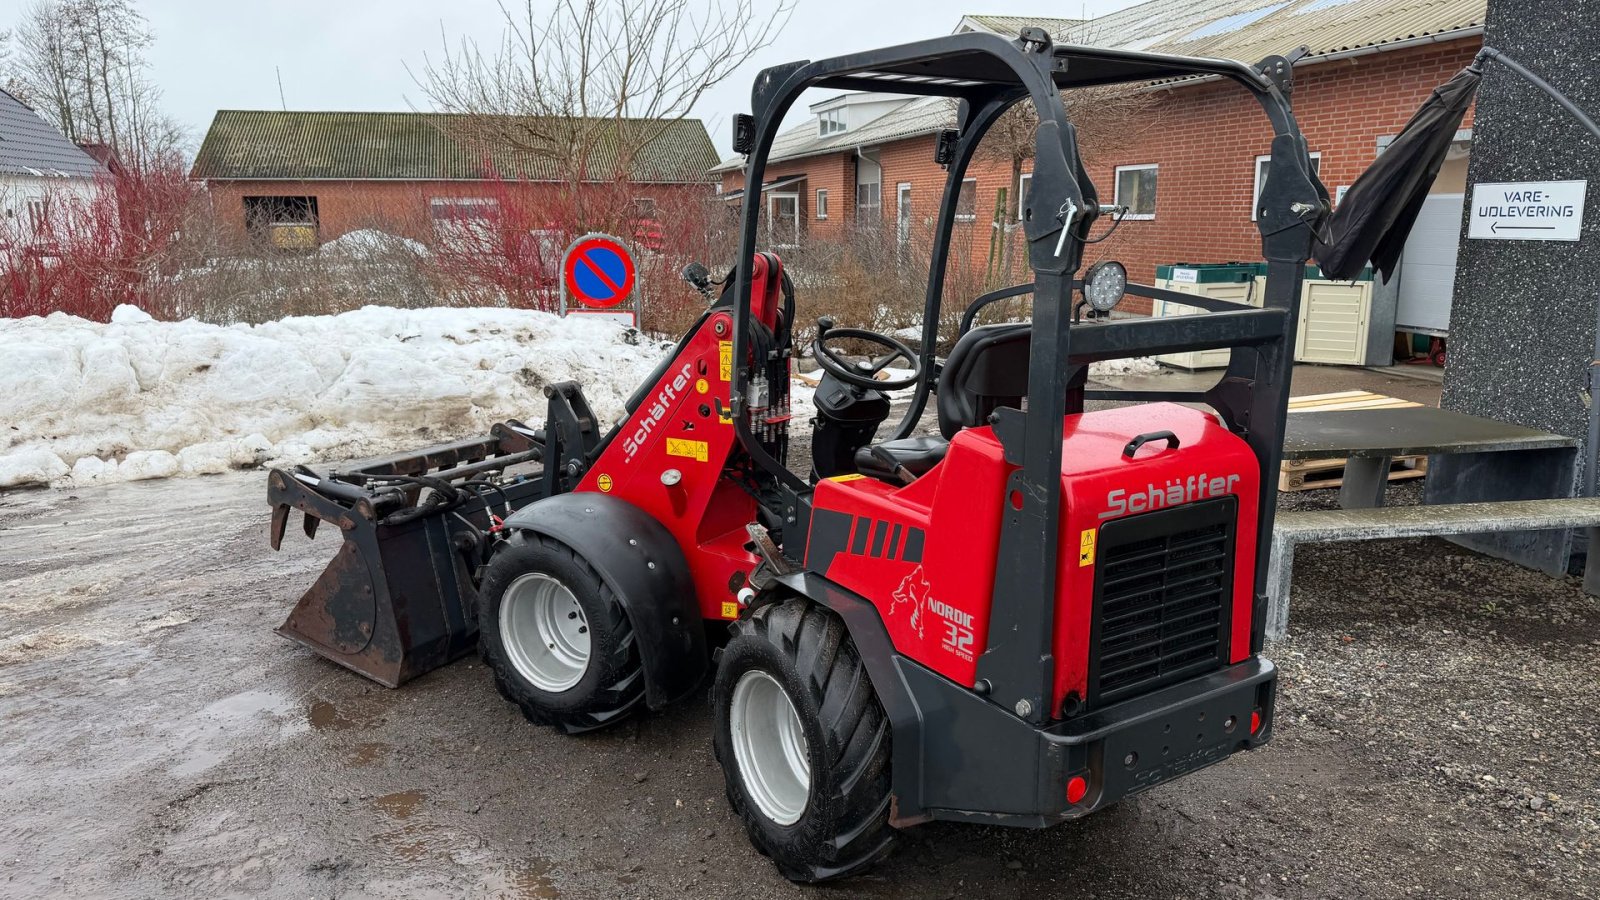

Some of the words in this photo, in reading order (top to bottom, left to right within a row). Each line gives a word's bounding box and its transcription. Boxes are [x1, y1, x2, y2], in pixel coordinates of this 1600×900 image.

[1479, 206, 1573, 217] UDLEVERING
[622, 363, 691, 464] Schäffer
[1098, 472, 1240, 519] Schäffer
[927, 596, 975, 630] NORDIC
[942, 620, 974, 655] 32
[955, 649, 973, 662] SPEED
